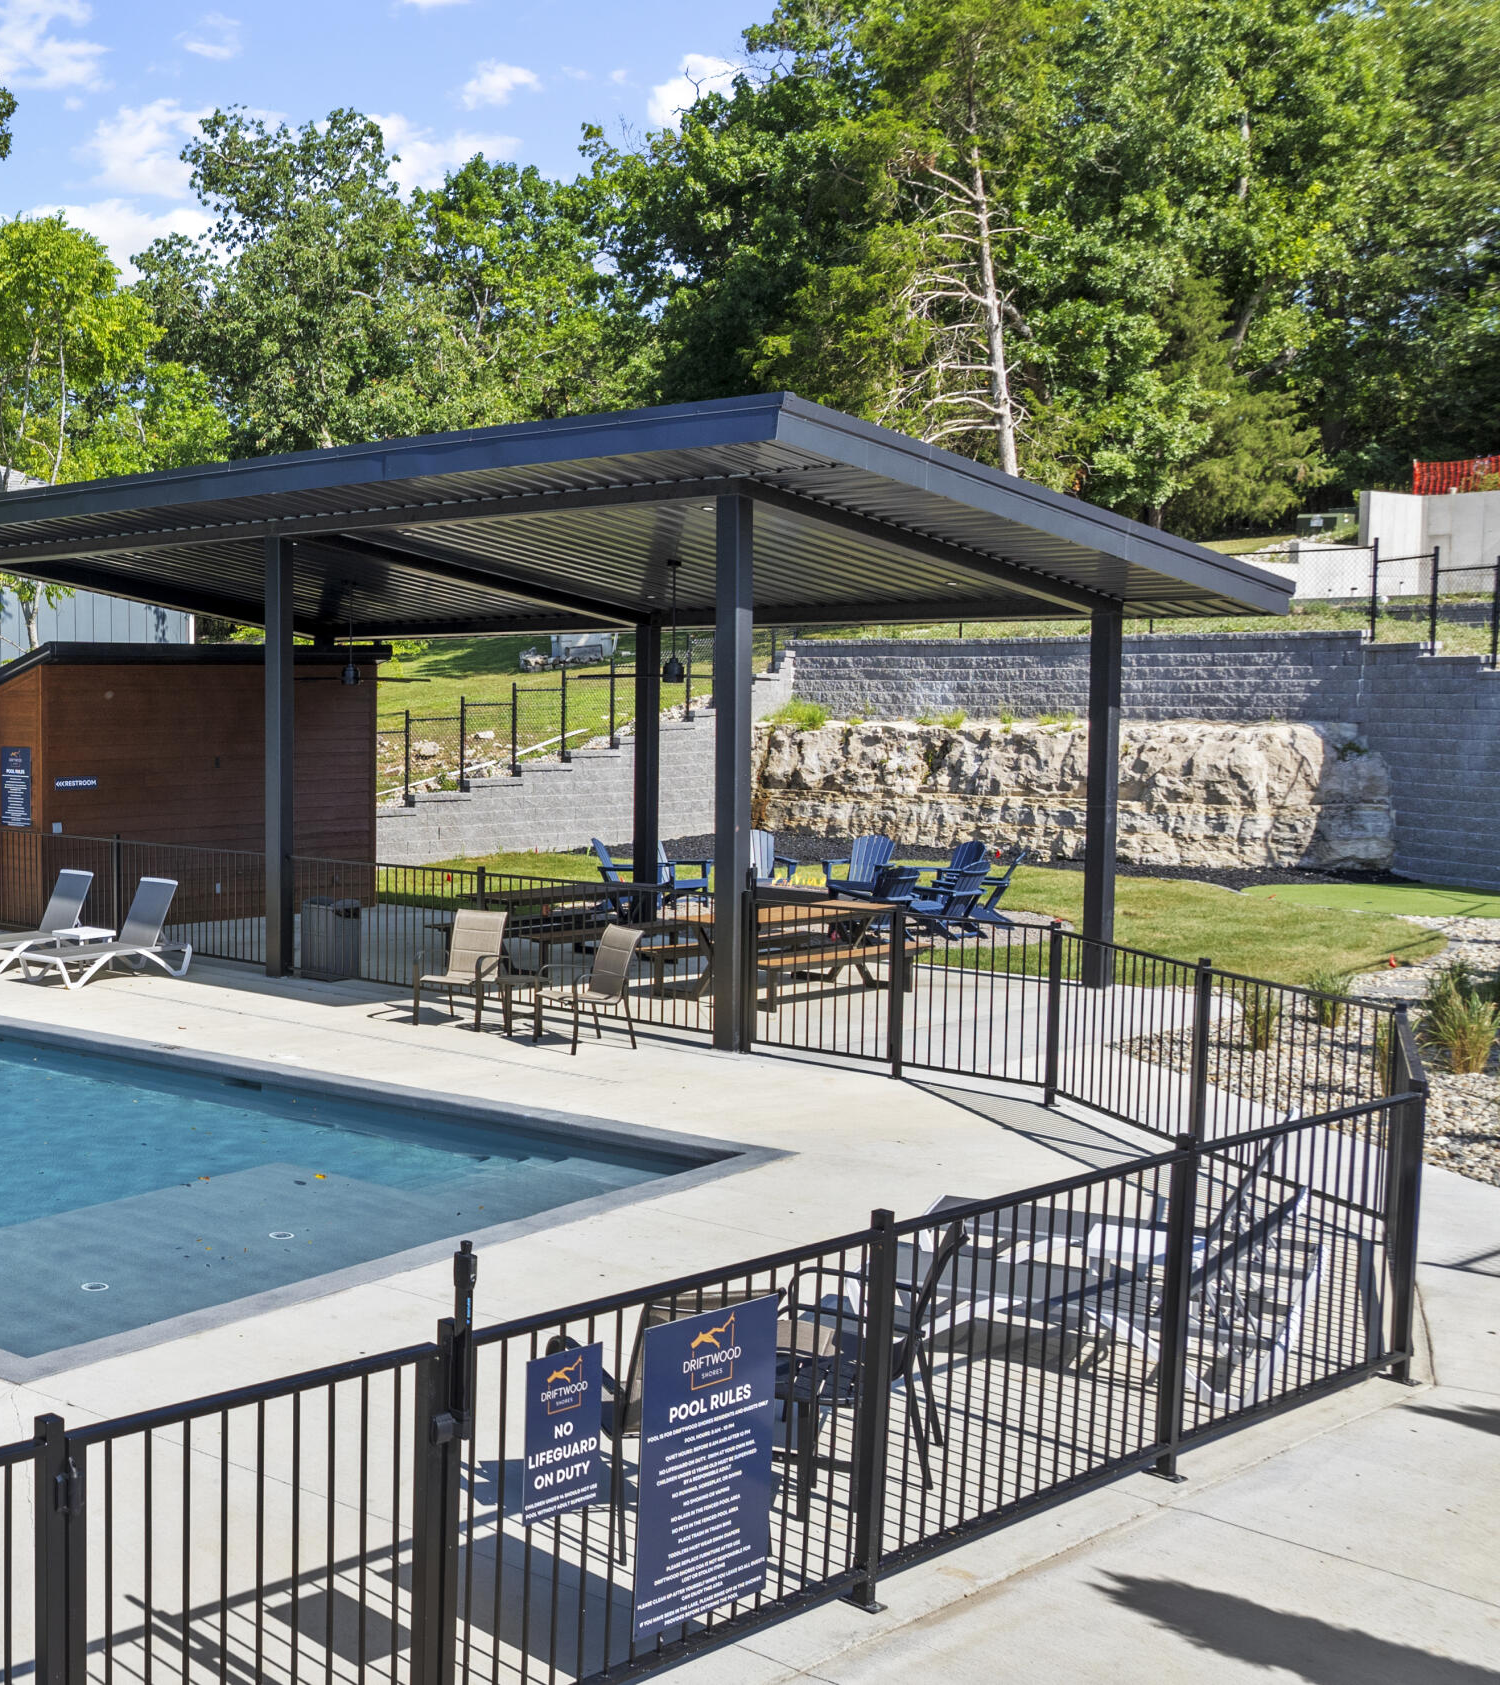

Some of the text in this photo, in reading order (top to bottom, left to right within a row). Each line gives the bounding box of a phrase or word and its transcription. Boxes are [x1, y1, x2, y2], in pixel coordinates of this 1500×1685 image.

[683, 1346, 742, 1374] DRIFTWOOD
[701, 1368, 723, 1379] SHORES
[541, 1381, 588, 1402] DRIFTWOOD
[669, 1383, 752, 1423] POOL RULES
[555, 1422, 574, 1439] NO
[528, 1437, 597, 1470] LIFEGUARD
[534, 1460, 590, 1490] ON DUTY
